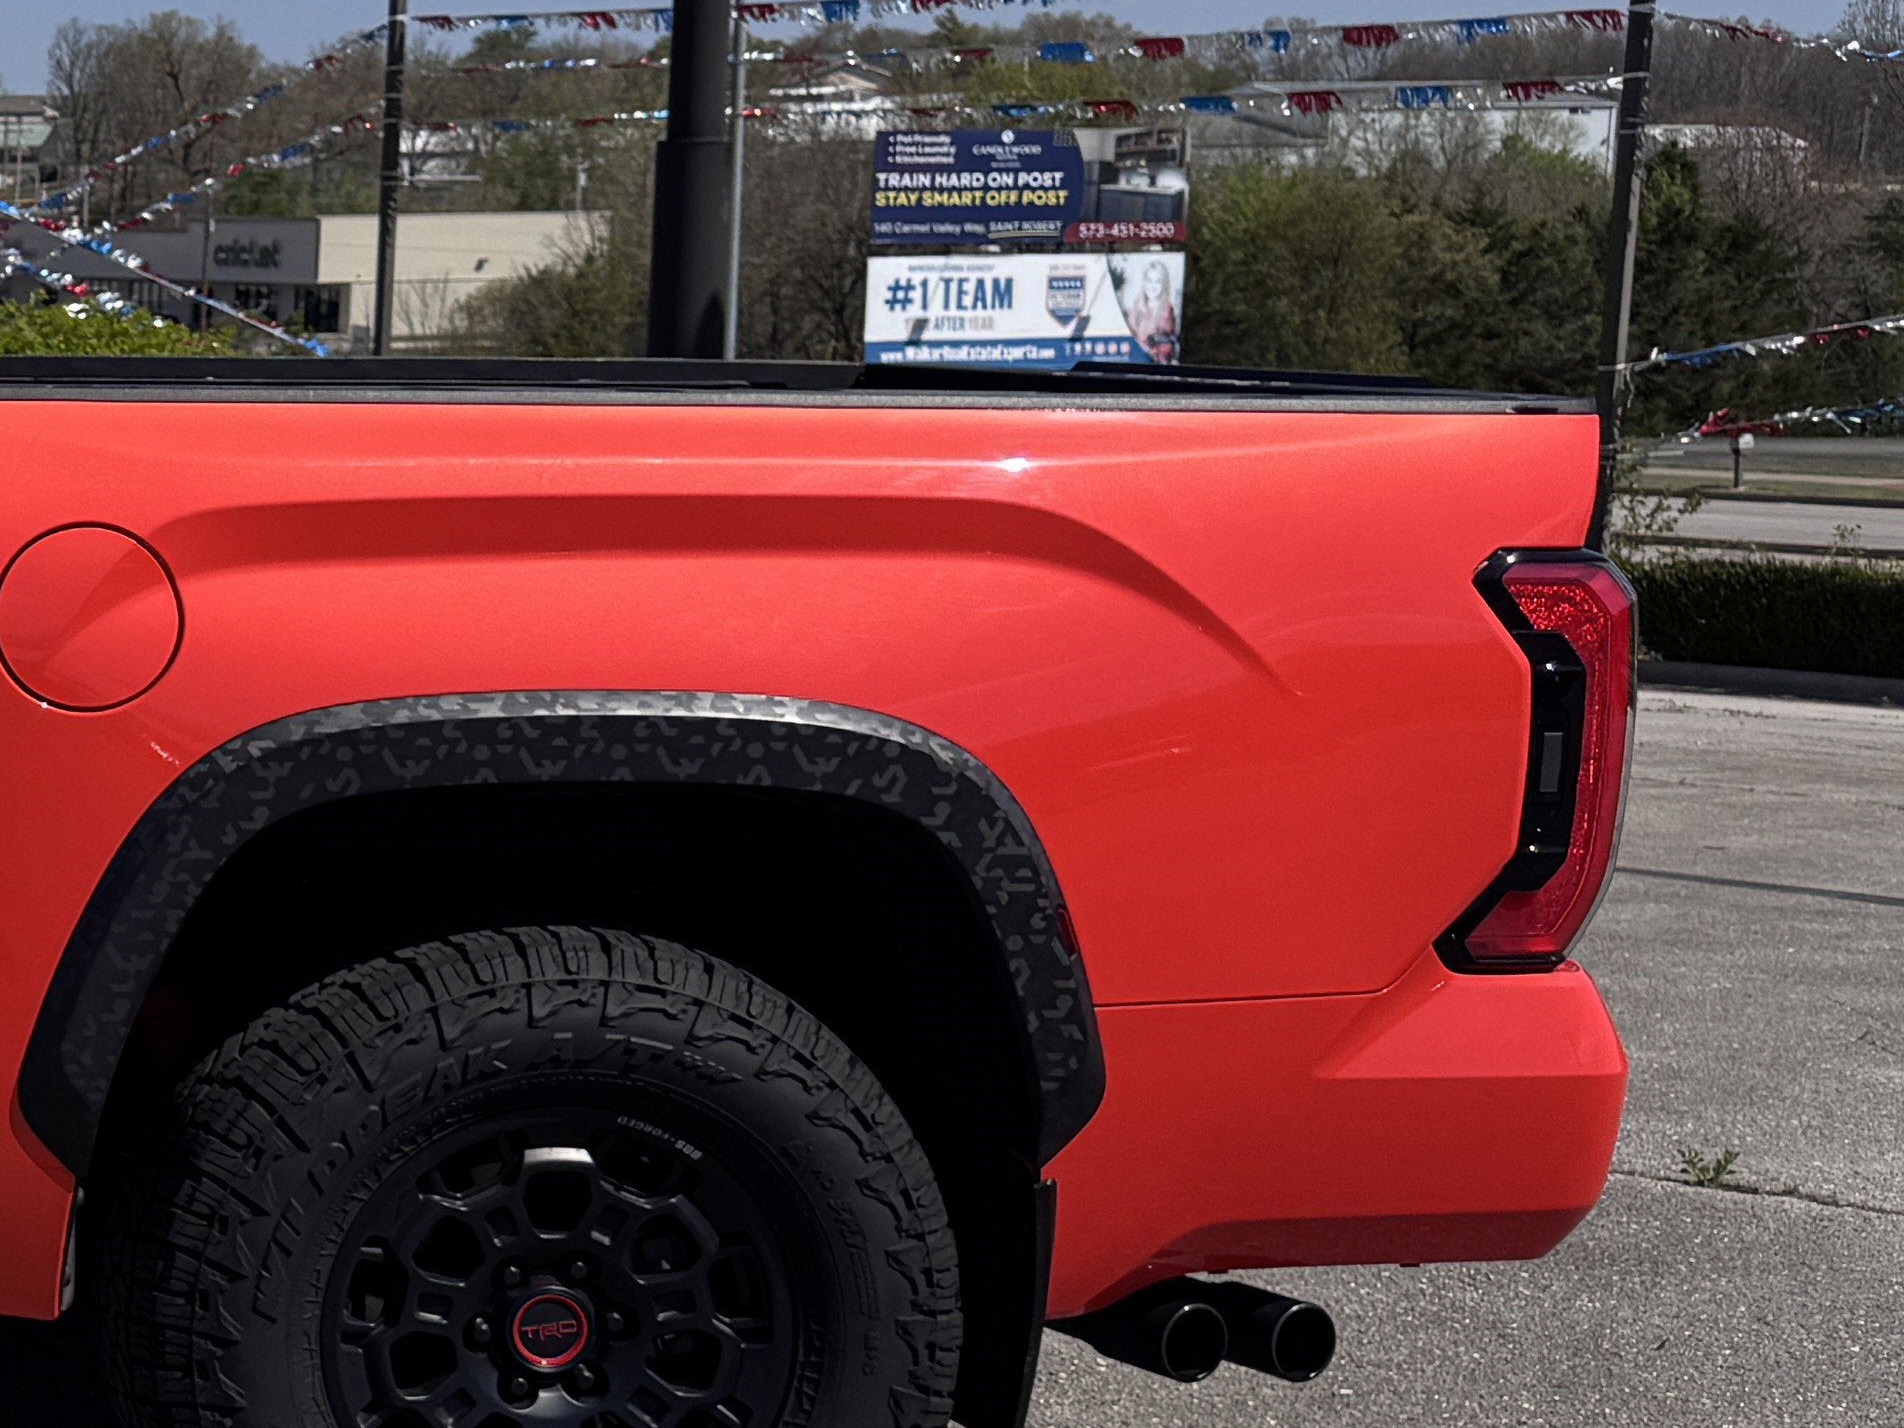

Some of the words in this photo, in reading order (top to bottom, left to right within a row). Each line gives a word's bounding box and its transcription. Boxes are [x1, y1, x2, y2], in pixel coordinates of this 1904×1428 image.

[875, 171, 932, 189] TRAIN
[934, 171, 985, 189] HARD
[986, 171, 1015, 188] ON
[1017, 171, 1065, 188] POST
[875, 190, 920, 207] STAY
[921, 190, 985, 207] SMART
[985, 190, 1020, 206] OFF
[1021, 189, 1069, 206] POST
[213, 237, 282, 269] cricket
[884, 277, 928, 311] #1
[939, 276, 1014, 311] TEAM
[933, 316, 966, 332] AFTER
[520, 1319, 579, 1342] TRD
